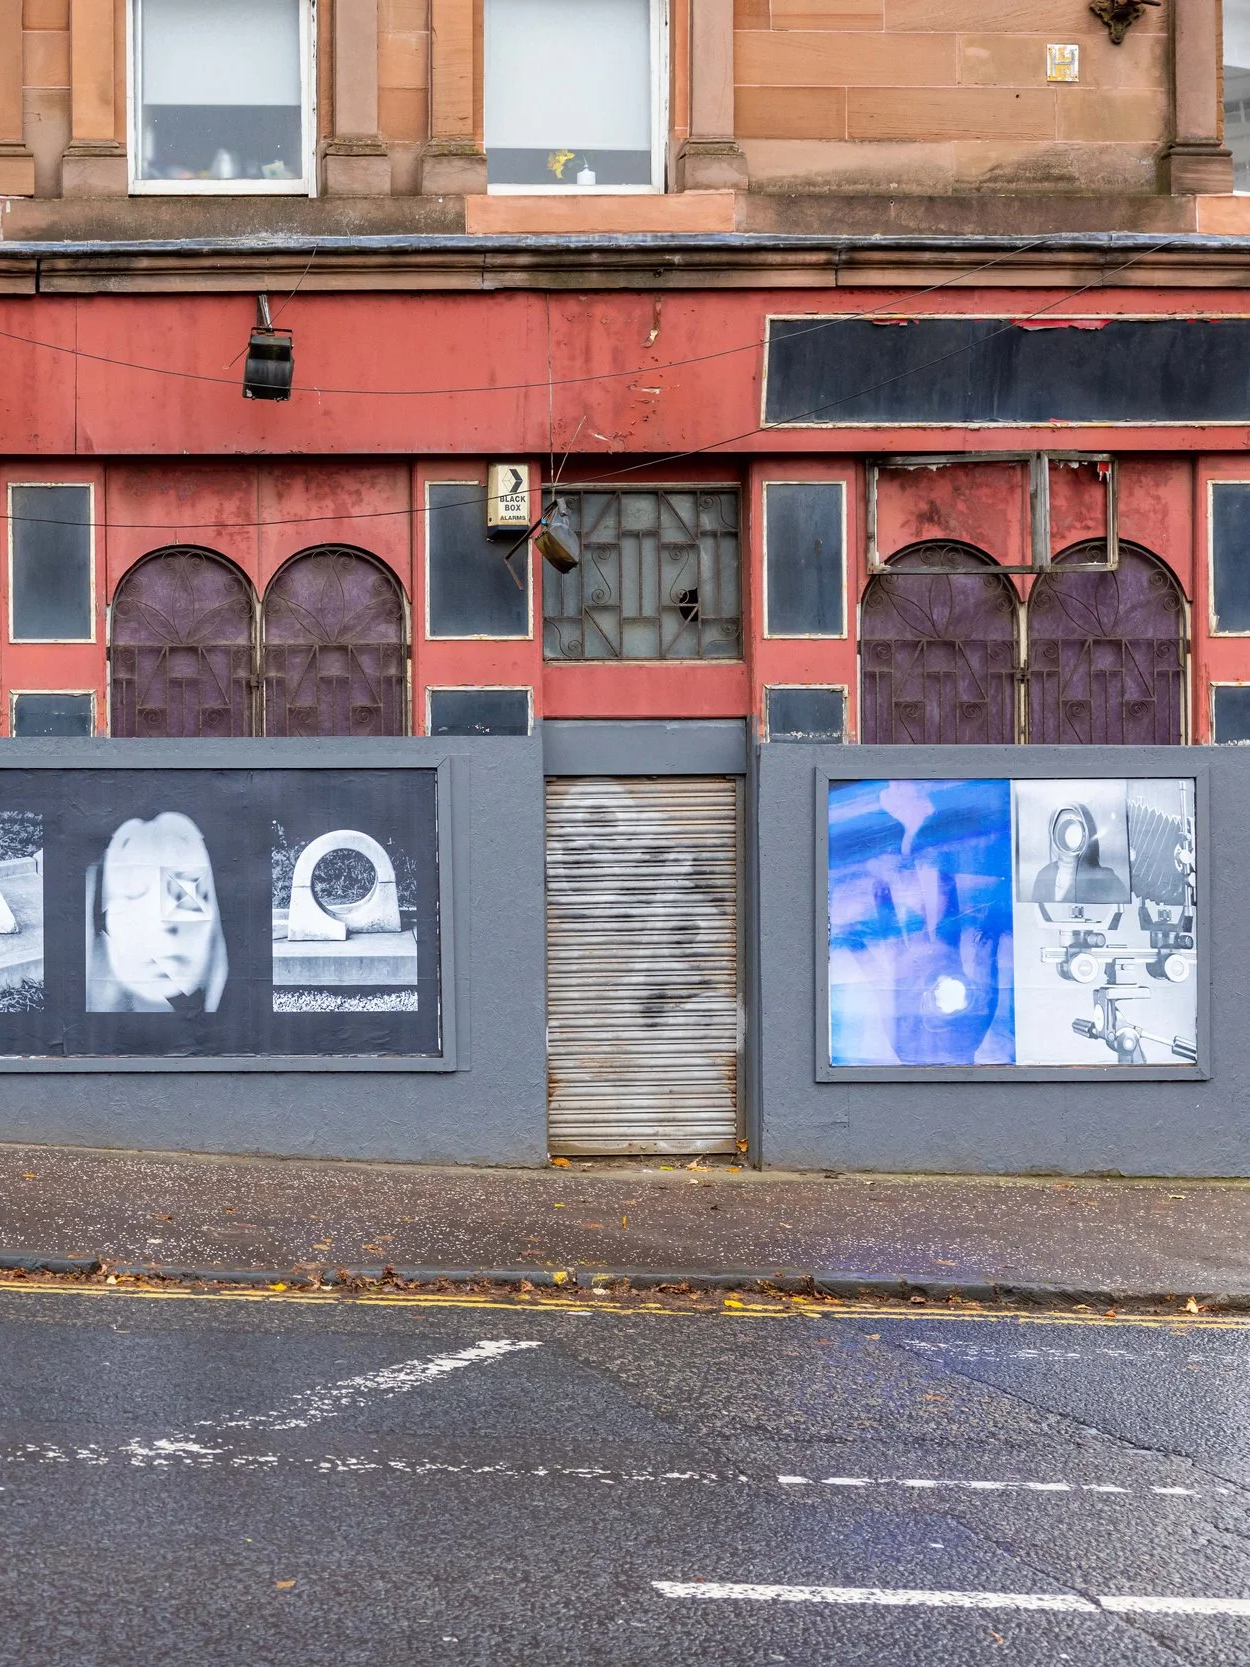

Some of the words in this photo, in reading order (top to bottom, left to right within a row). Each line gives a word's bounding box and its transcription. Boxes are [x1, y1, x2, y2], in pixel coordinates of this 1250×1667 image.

[1051, 48, 1075, 78] H
[500, 495, 526, 503] BLACK
[504, 504, 521, 512] BOX
